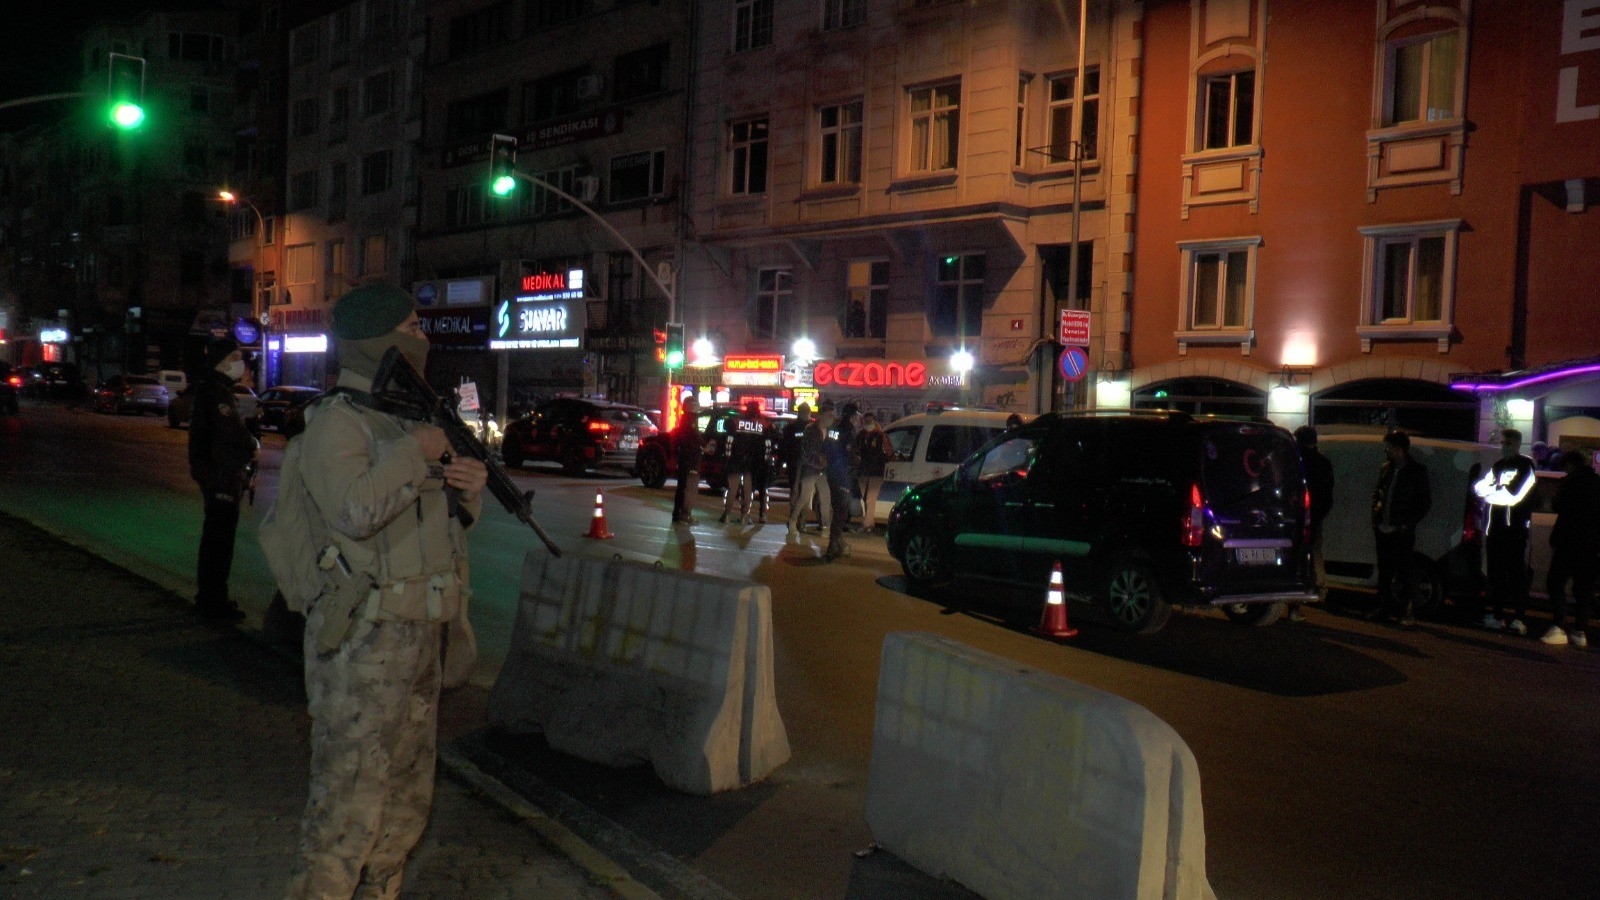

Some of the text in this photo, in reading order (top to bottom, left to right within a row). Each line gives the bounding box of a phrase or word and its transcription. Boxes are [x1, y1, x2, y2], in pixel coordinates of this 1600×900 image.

[523, 271, 565, 291] MEDİKAL
[434, 315, 471, 334] MEDİKAL
[1014, 321, 1019, 329] 4
[814, 361, 926, 387] eczane
[738, 420, 763, 433] POLİS
